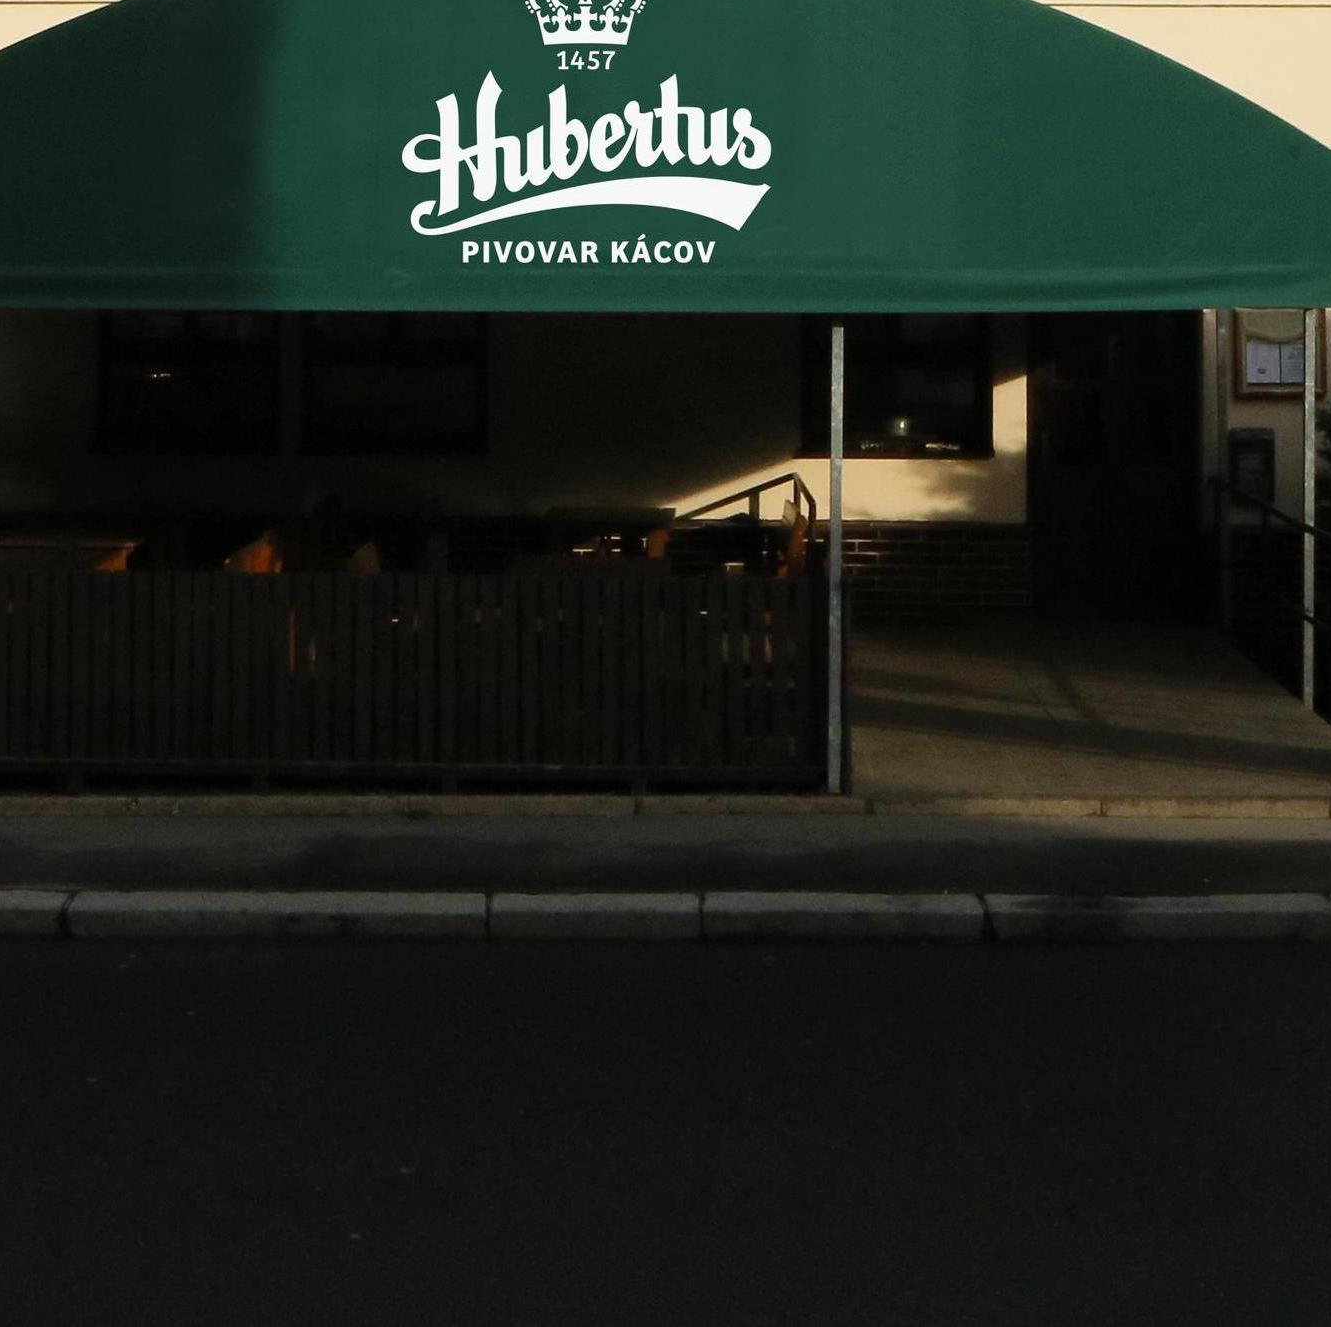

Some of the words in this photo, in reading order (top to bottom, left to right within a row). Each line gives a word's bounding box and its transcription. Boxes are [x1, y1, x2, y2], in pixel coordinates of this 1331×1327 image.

[556, 50, 616, 71] 1457
[401, 70, 772, 217] Hubertus
[462, 240, 599, 264] PIVOVAR
[611, 233, 716, 264] KÁCOV
